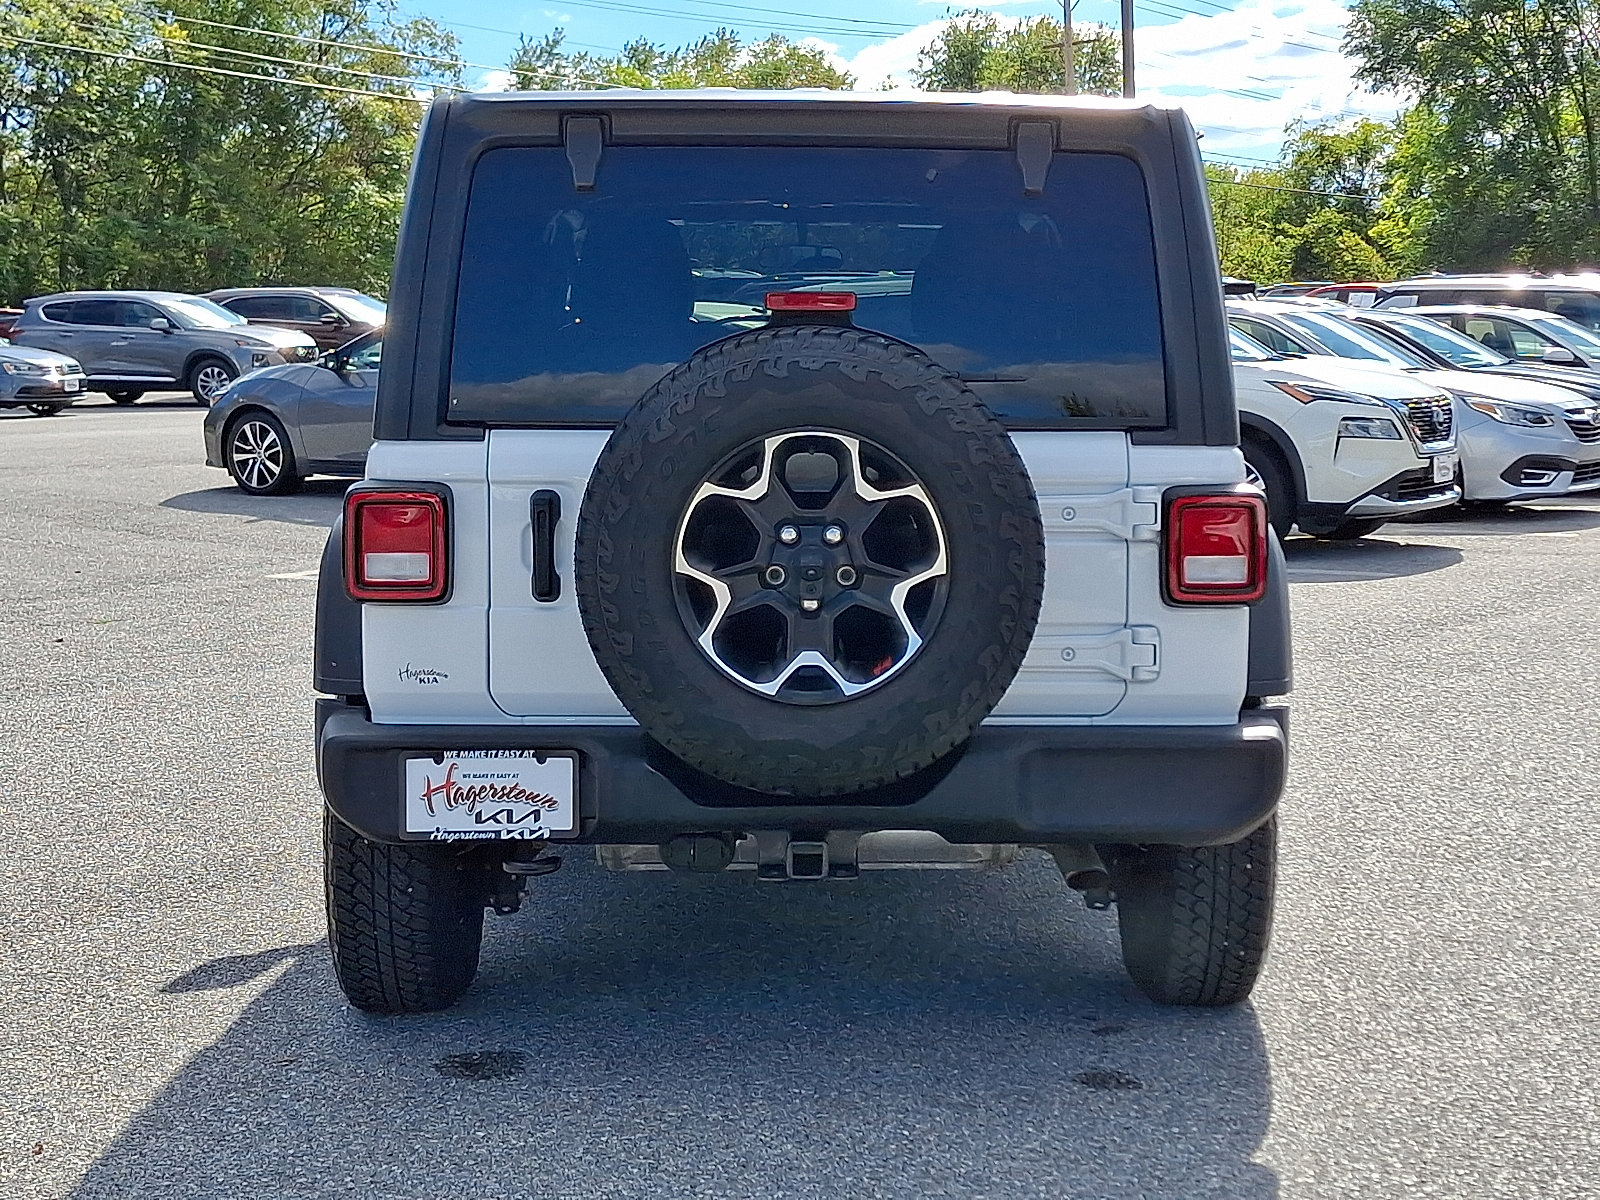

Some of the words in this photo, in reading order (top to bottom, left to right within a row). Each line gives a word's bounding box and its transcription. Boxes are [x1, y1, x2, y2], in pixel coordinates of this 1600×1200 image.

[444, 750, 459, 759] WE
[460, 750, 486, 759] MAKE
[487, 750, 497, 759] IT
[498, 750, 522, 759] EASY
[523, 750, 535, 759] AT
[421, 763, 559, 814] Hagerstown
[430, 828, 495, 843] Hagerstown
